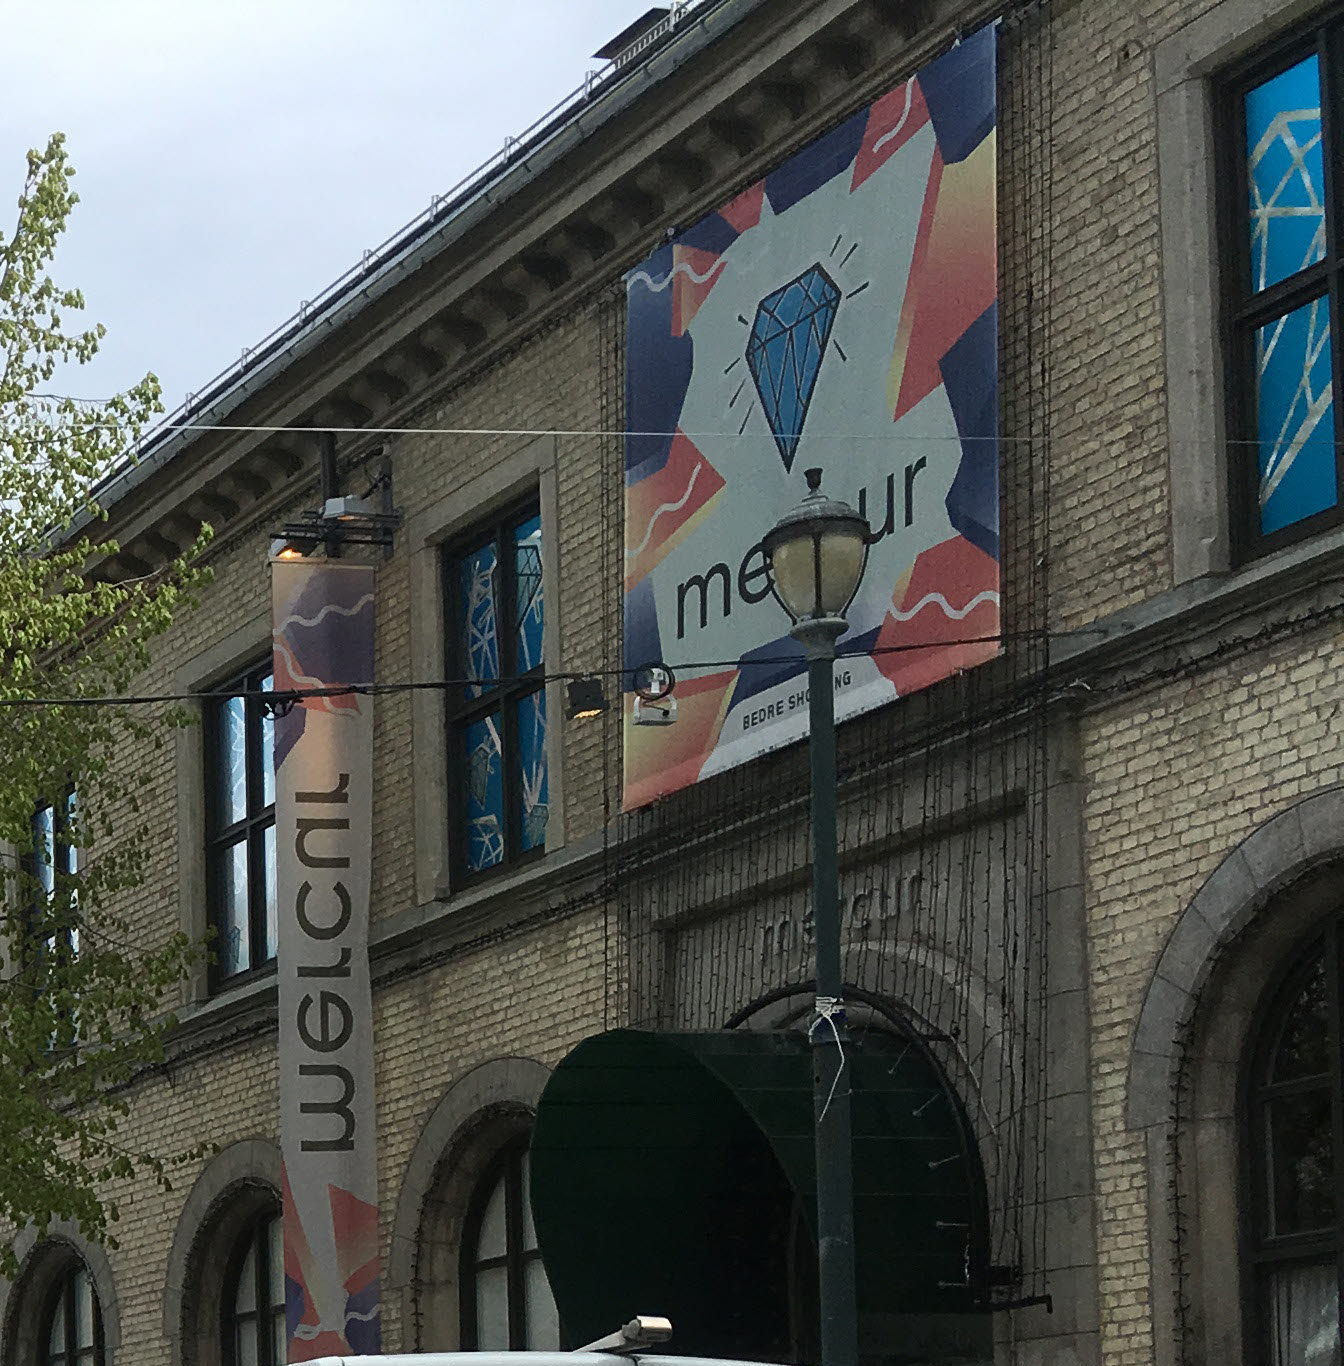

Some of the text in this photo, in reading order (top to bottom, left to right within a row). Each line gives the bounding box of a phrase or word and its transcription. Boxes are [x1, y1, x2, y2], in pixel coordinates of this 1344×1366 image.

[677, 456, 927, 640] meur
[743, 670, 852, 731] BEDRE SHONG
